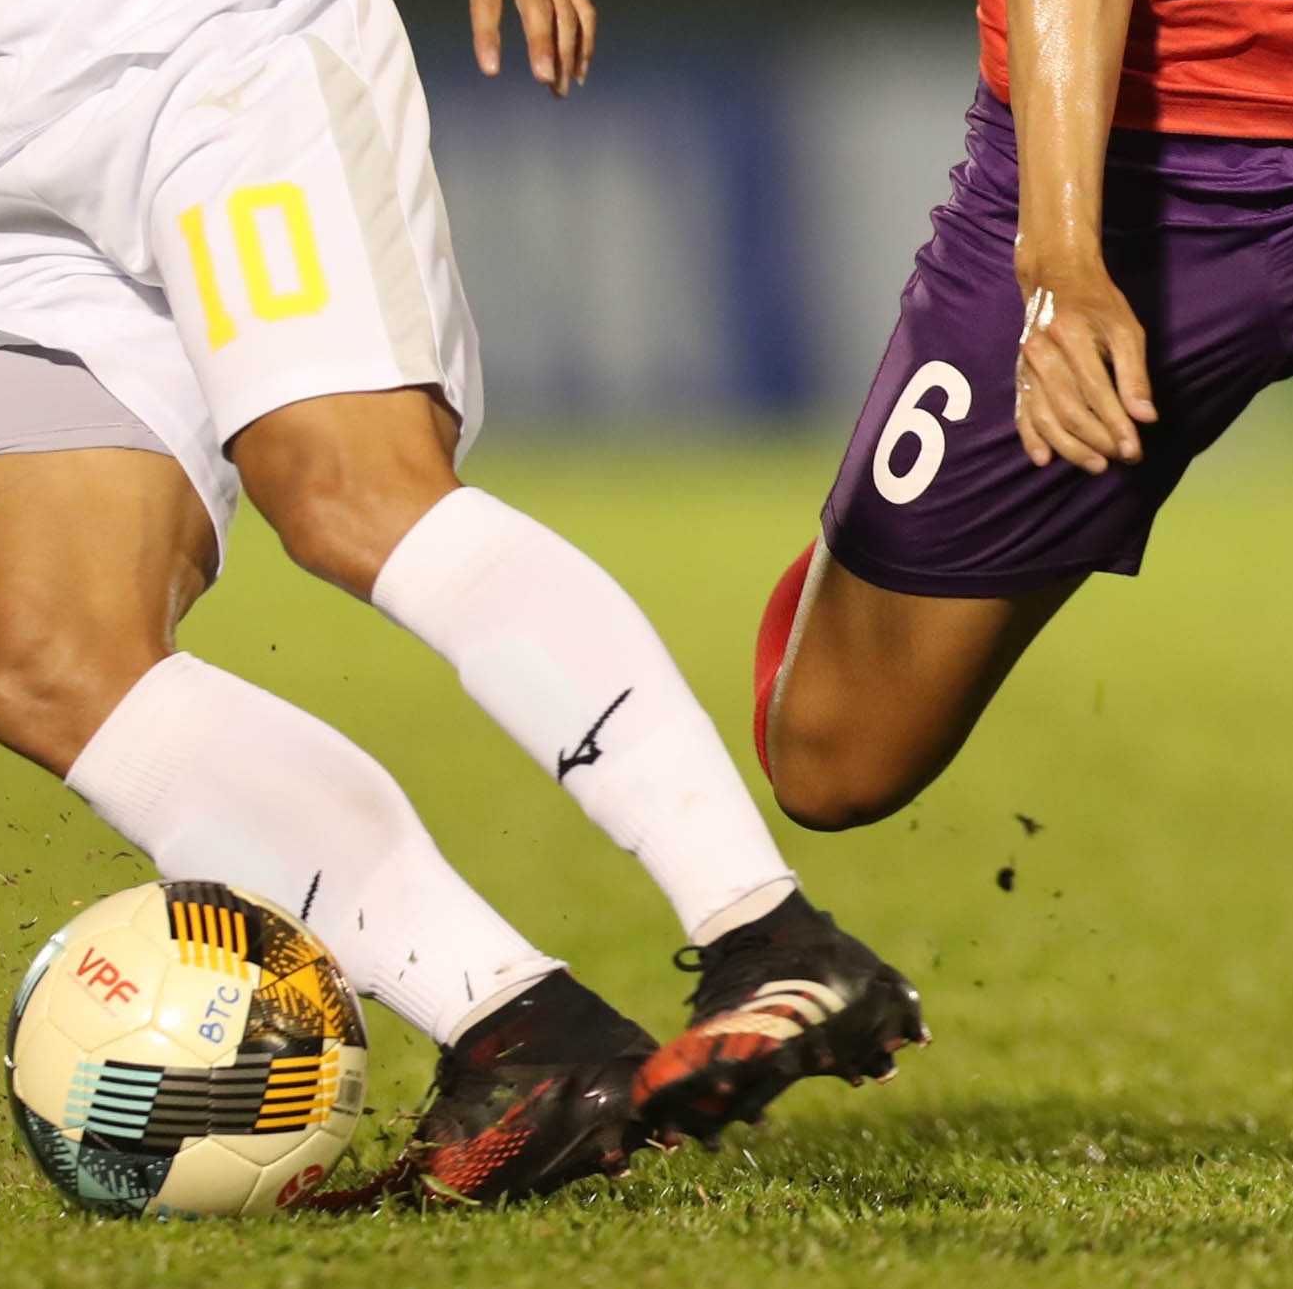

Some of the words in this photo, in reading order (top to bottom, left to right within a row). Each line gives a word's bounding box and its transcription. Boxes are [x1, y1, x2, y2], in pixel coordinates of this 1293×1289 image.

[177, 179, 332, 355] 10
[872, 360, 973, 505] 6
[73, 946, 140, 1004] VPF
[197, 985, 241, 1044] BTC
